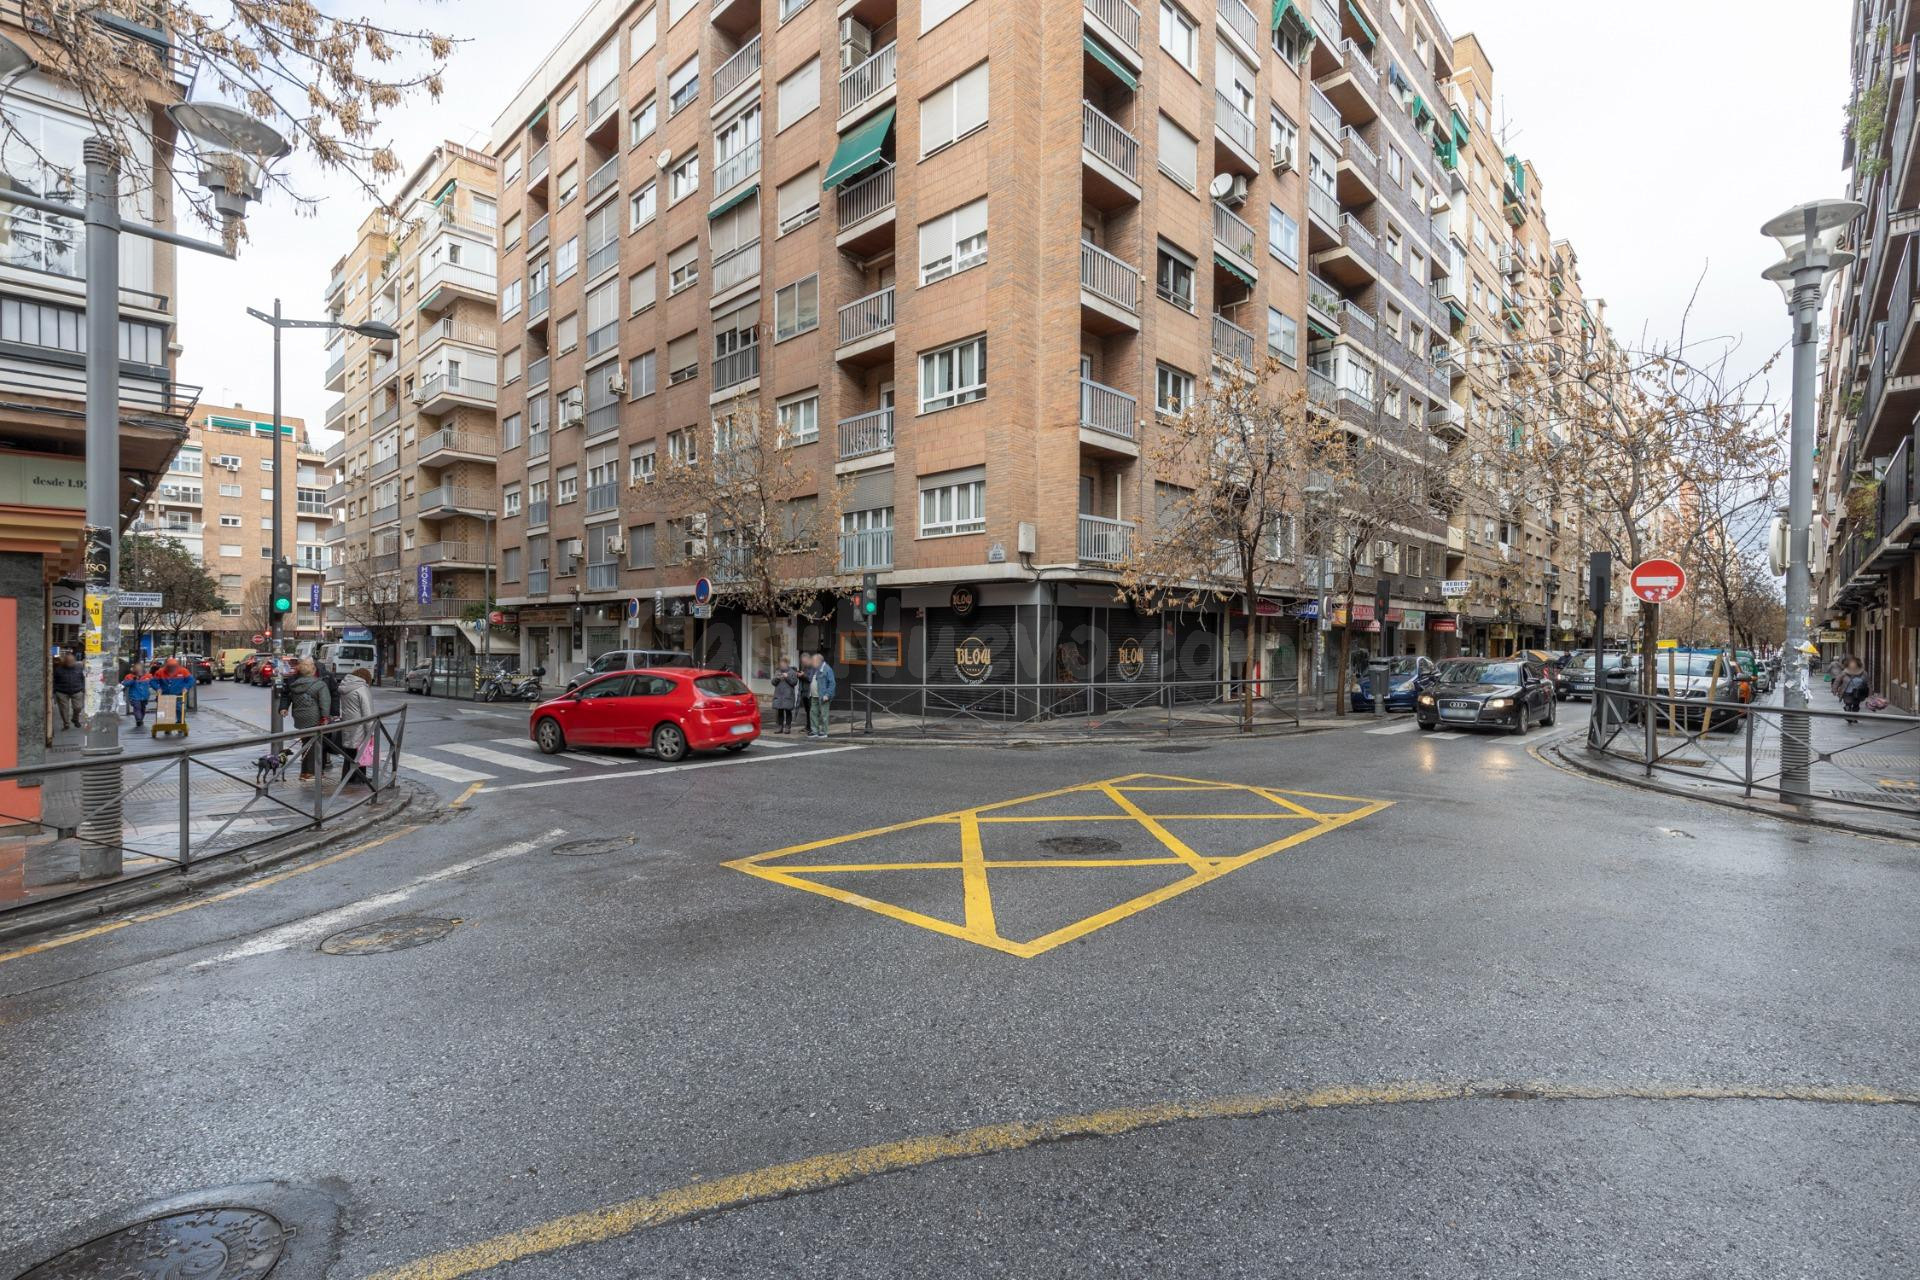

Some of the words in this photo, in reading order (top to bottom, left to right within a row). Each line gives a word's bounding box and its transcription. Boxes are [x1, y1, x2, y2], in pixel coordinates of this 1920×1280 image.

[32, 476, 65, 487] desde
[421, 566, 429, 604] HOSTAL
[53, 600, 80, 609] odo
[952, 594, 973, 605] BLOW
[955, 647, 991, 665] BLOW
[1119, 647, 1144, 664] BLOW
